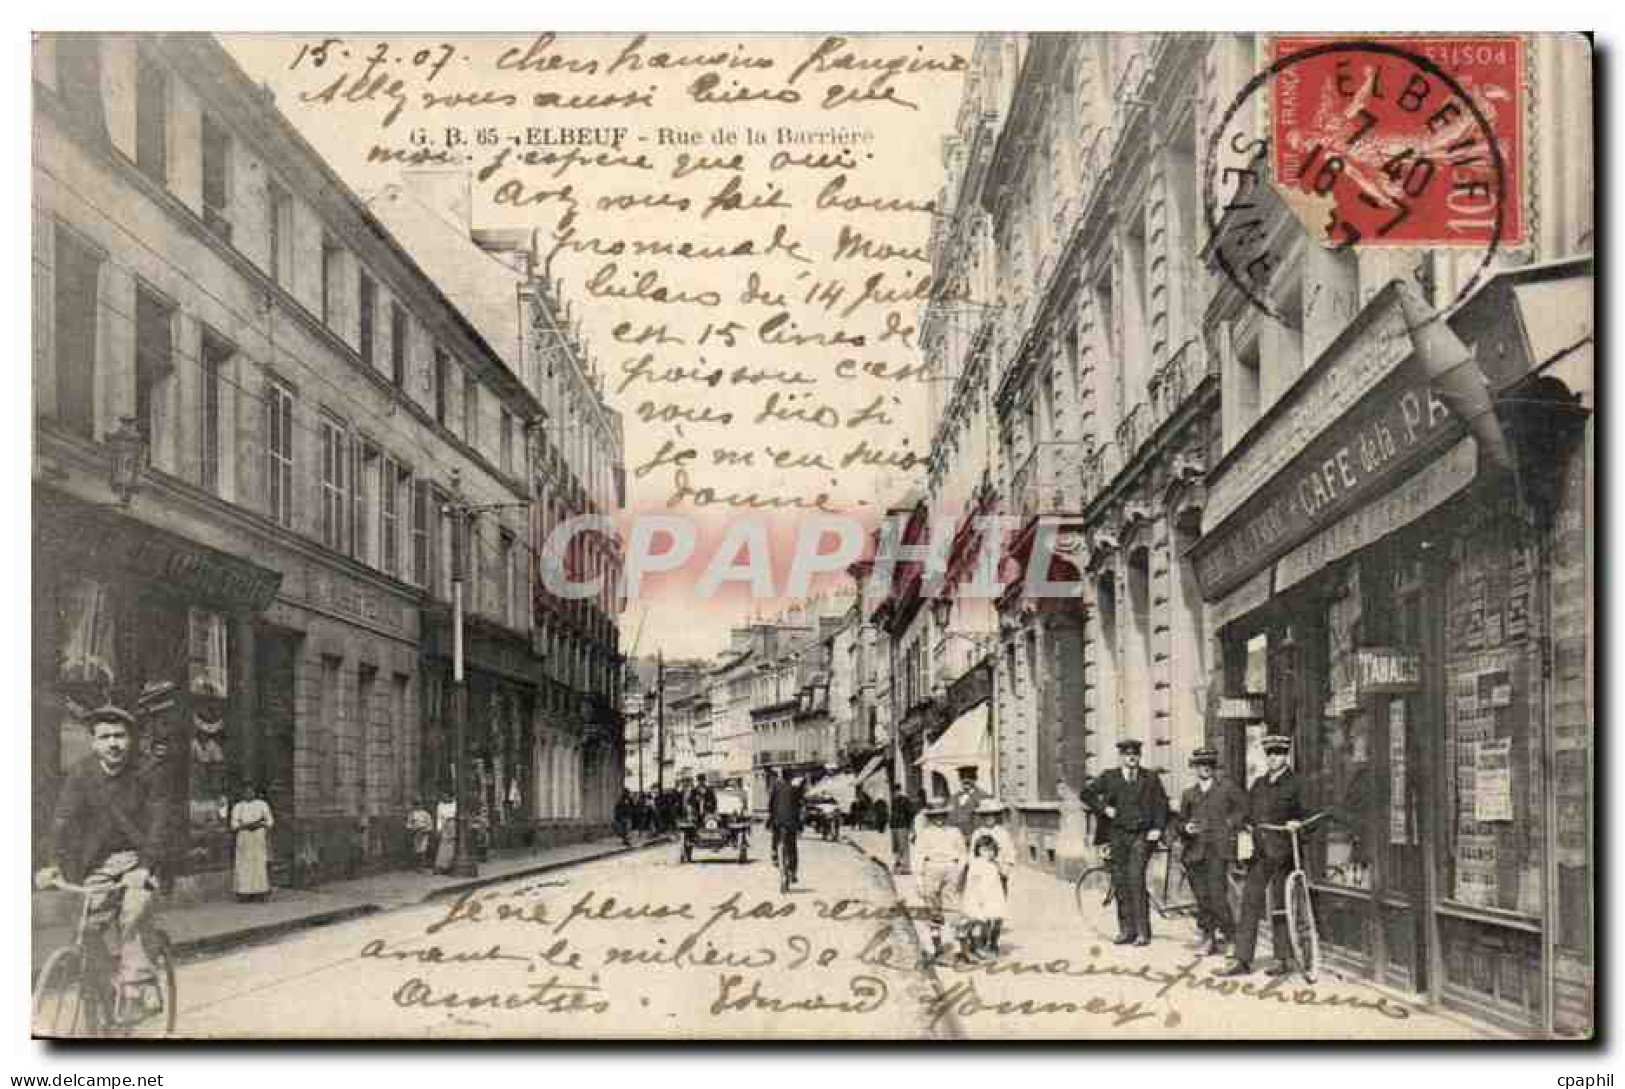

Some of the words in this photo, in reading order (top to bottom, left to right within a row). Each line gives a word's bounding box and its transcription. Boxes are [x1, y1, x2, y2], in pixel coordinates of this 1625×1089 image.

[447, 128, 467, 146] B.
[477, 128, 498, 146] 65
[526, 127, 629, 146] ELBEUF
[657, 128, 703, 146] Rue
[711, 127, 738, 146] de
[745, 127, 766, 146] la
[805, 280, 847, 306] 14
[698, 321, 748, 348] 15
